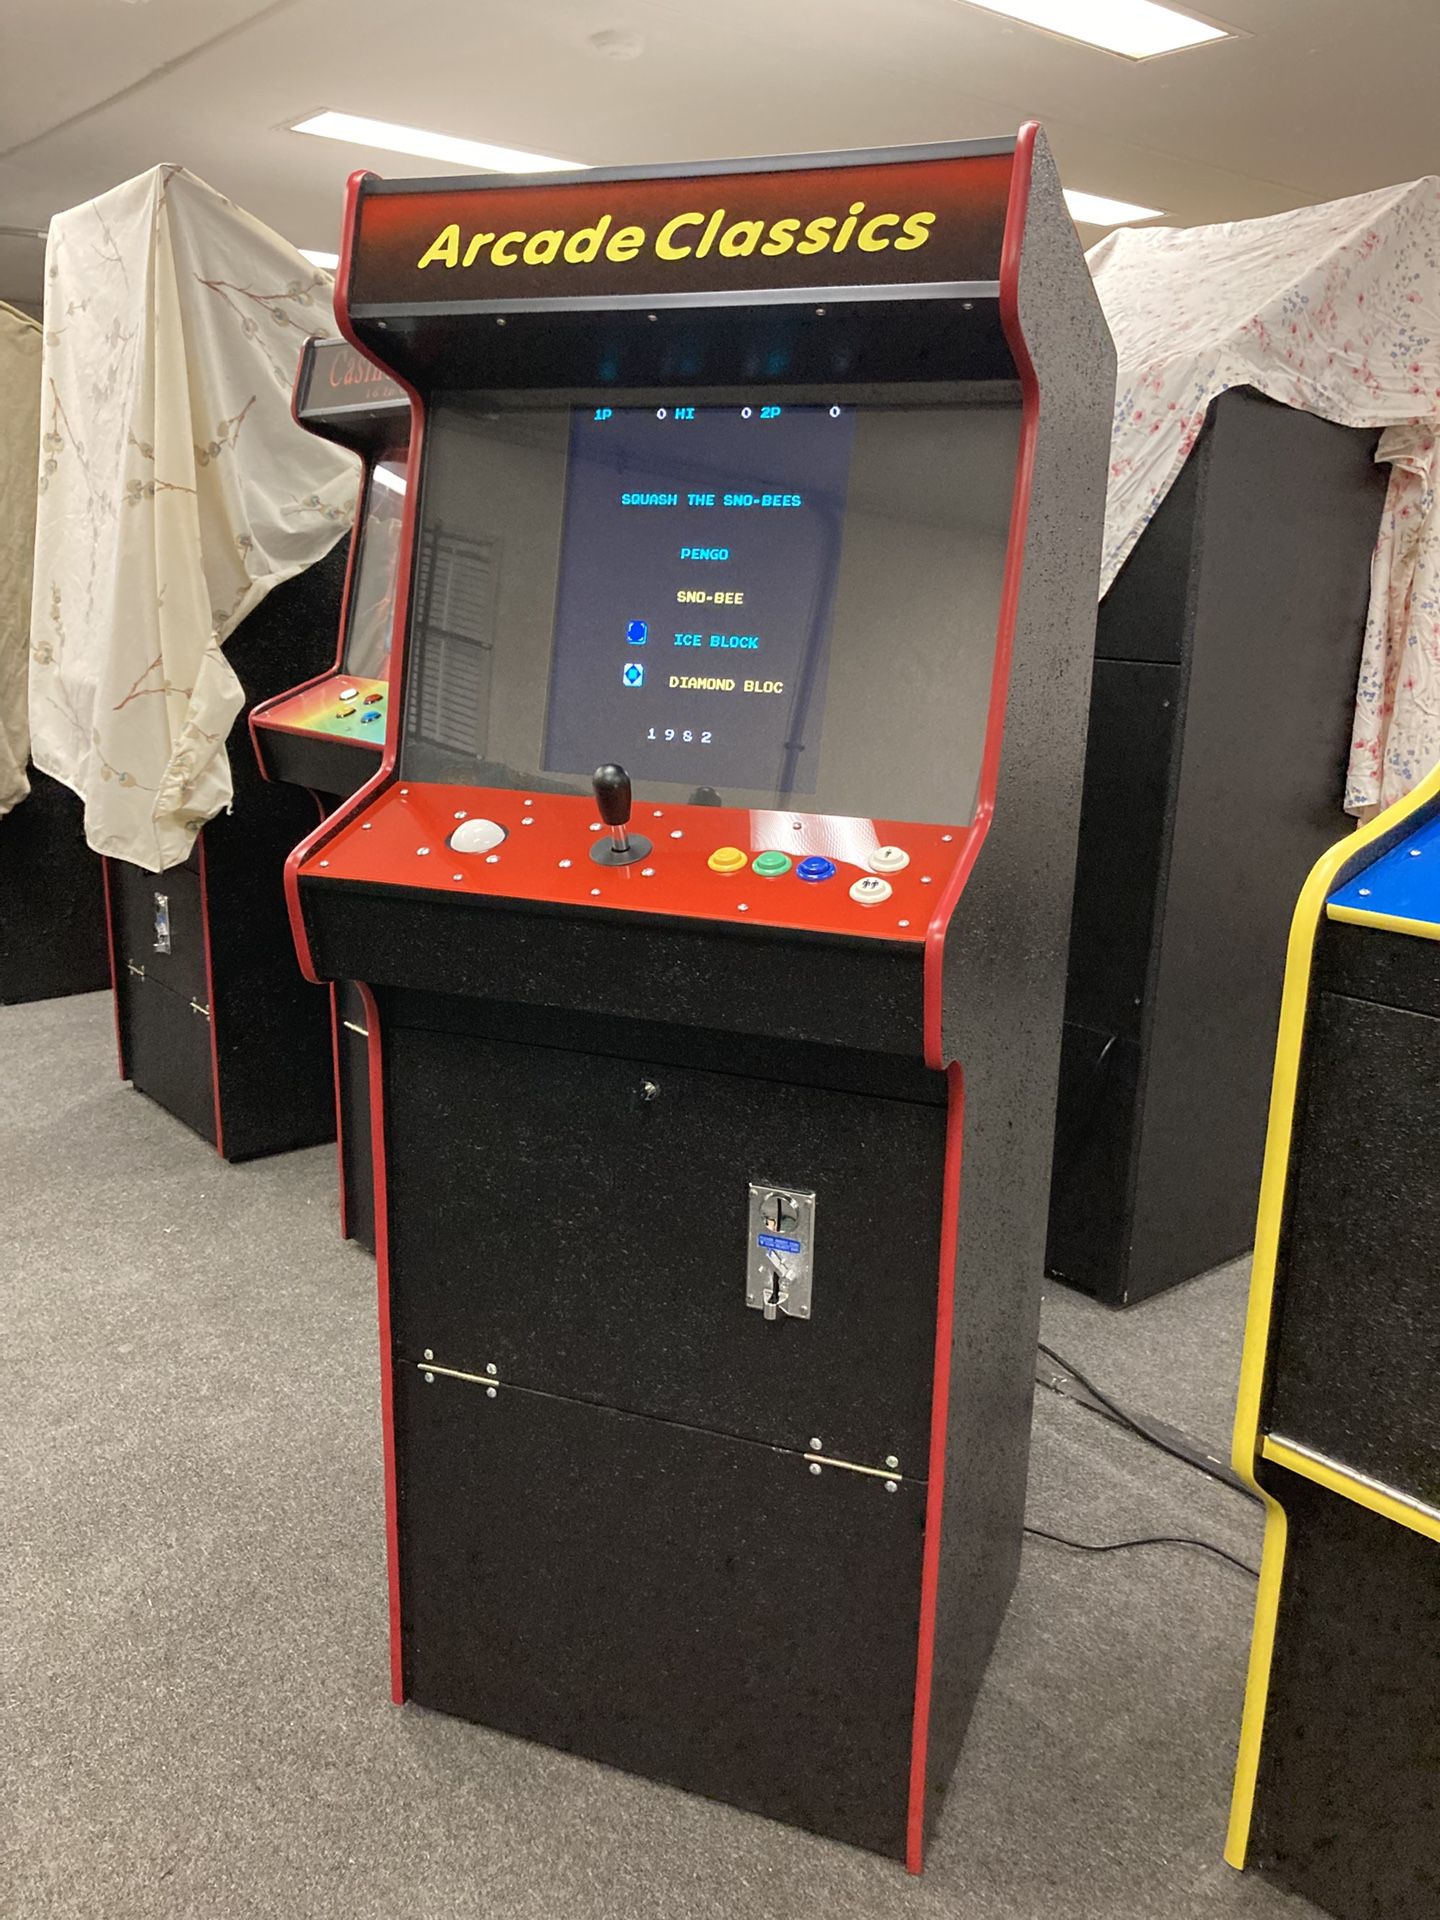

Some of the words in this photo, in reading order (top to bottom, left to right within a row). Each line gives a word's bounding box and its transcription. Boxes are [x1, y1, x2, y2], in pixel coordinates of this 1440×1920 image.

[417, 214, 646, 269] Arcade
[655, 201, 936, 261] Classics
[594, 408, 612, 421] 1P
[674, 407, 695, 420] HI
[759, 406, 781, 419] 2P
[621, 493, 678, 506] SQUASH
[687, 493, 716, 506] THE
[723, 494, 802, 507] SNO-BEES
[680, 547, 729, 561] PENGO
[676, 590, 745, 605] SNO-BEE
[673, 633, 703, 647] ICE
[709, 635, 759, 650] BLOCK
[668, 675, 736, 692] DIAMOND
[743, 679, 784, 694] BLOC
